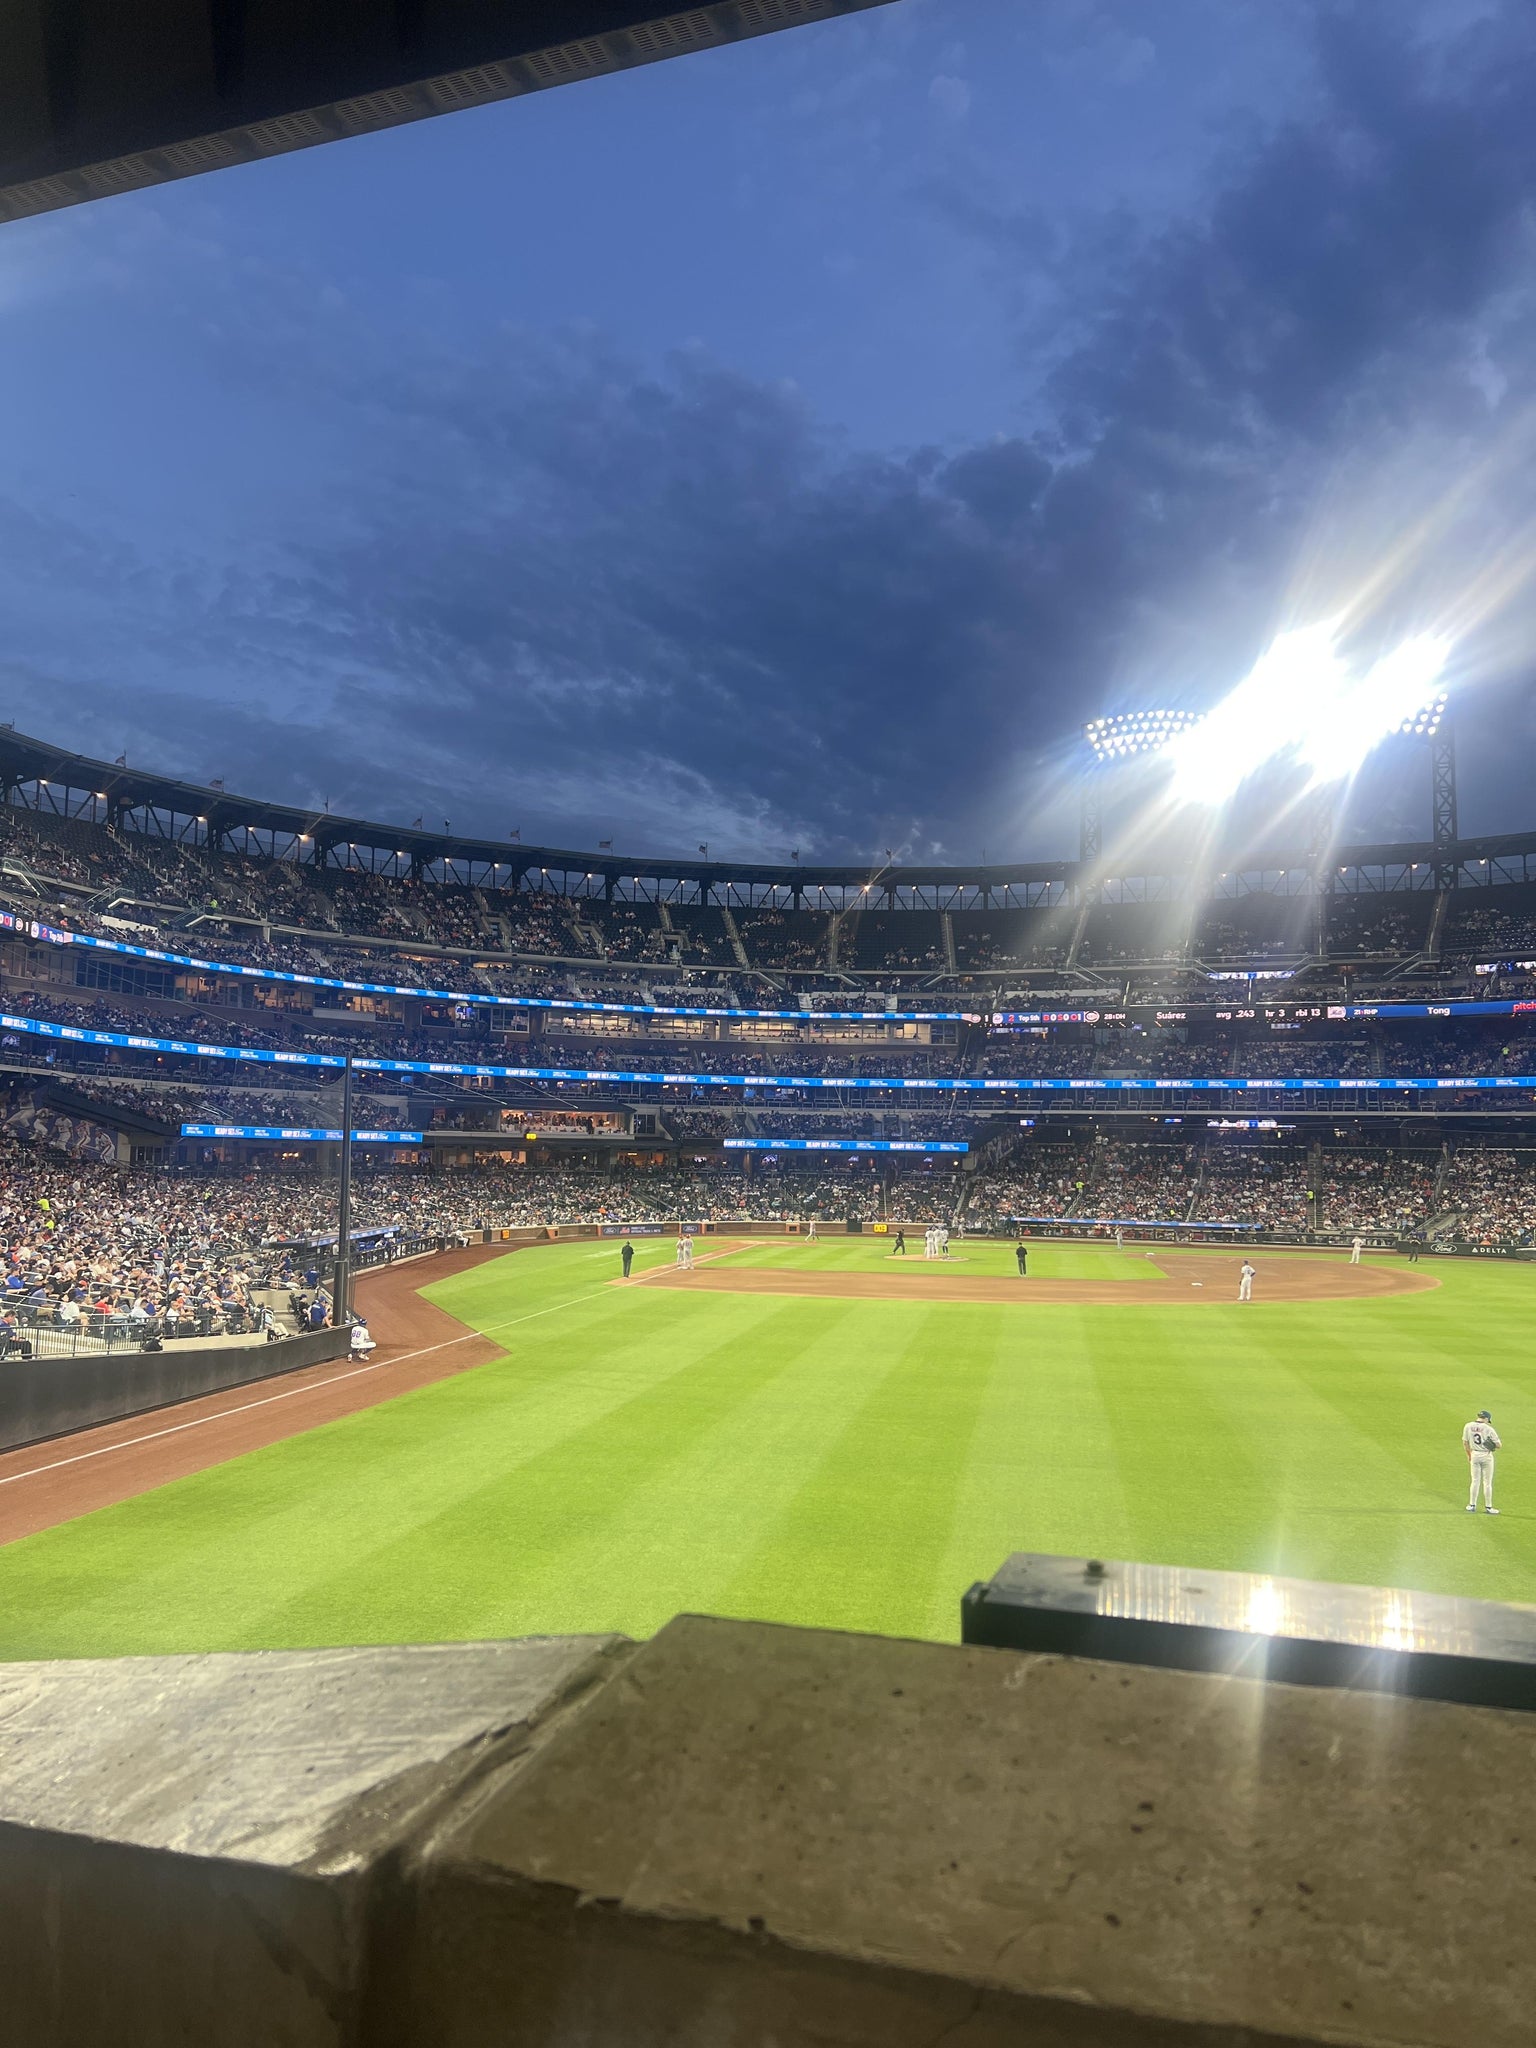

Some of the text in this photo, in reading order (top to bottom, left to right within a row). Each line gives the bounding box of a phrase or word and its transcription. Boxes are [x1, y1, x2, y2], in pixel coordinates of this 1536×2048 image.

[42, 928, 47, 938] 2
[1156, 1011, 1186, 1019] Suárez
[1235, 1010, 1255, 1018] .243
[1278, 1009, 1285, 1017] 3
[1427, 1007, 1450, 1016] Tong
[1008, 1014, 1015, 1022] 2
[1434, 1243, 1454, 1252] Ford
